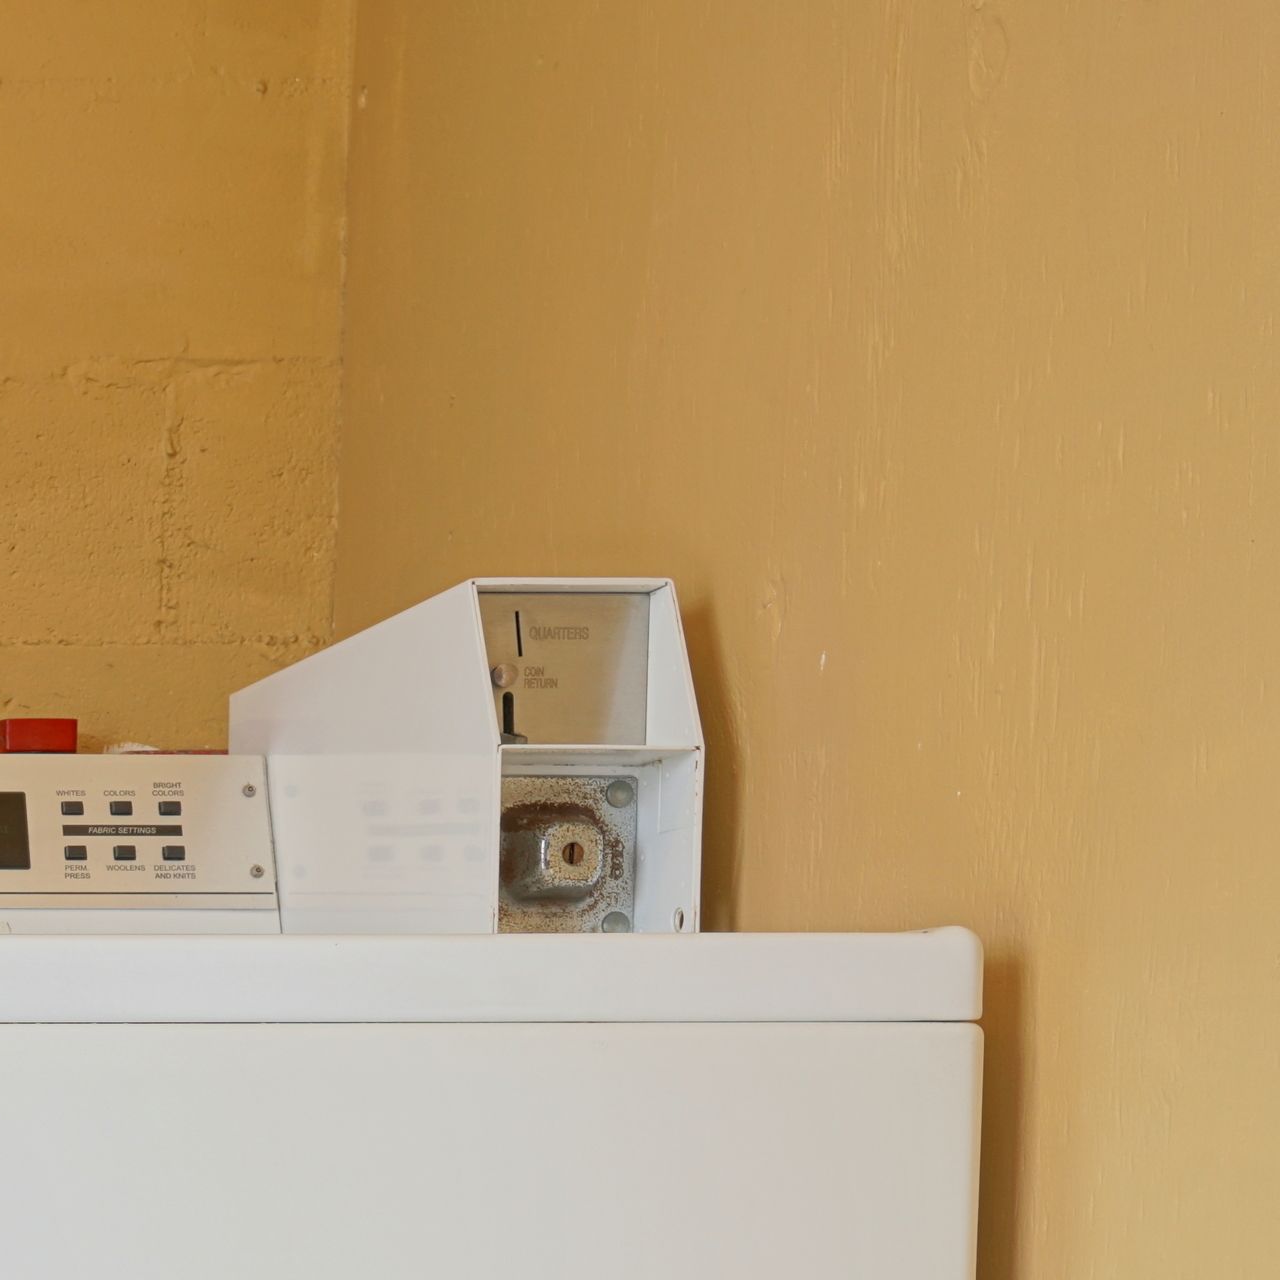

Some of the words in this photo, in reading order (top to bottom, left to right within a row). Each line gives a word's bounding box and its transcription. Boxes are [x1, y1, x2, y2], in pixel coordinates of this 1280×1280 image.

[529, 626, 589, 640] QUARTERS
[524, 666, 545, 677] COIN
[524, 678, 558, 689] RETURN
